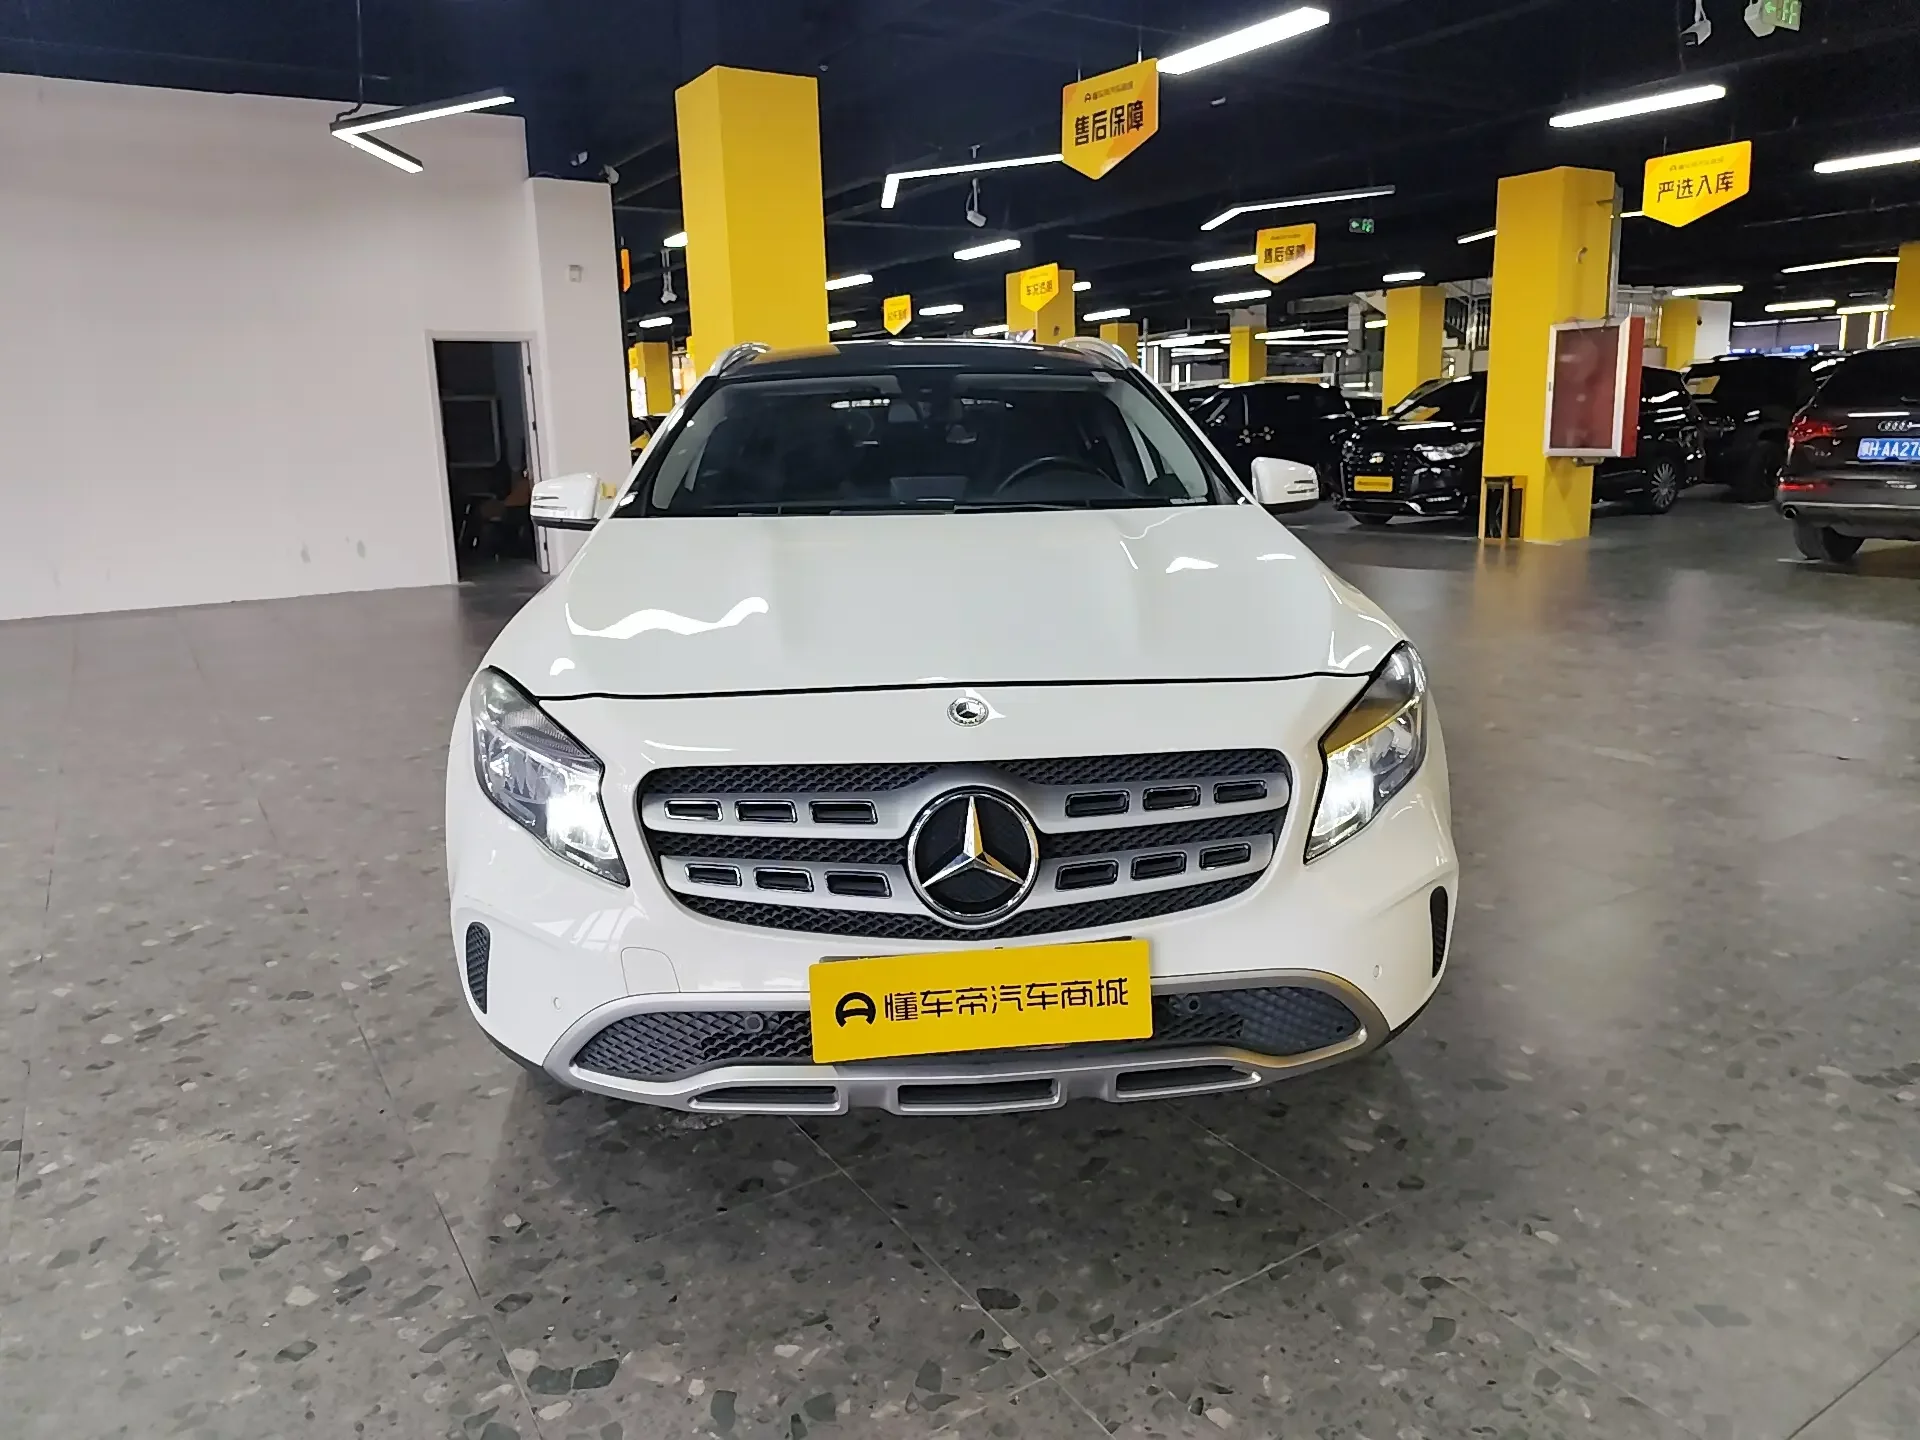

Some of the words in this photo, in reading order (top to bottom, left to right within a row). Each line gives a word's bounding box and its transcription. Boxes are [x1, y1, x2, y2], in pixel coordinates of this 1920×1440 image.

[1074, 99, 1144, 147] 售后保障
[1656, 170, 1735, 203] 严选入库
[883, 976, 1129, 1022] 懂车帝汽车商城
